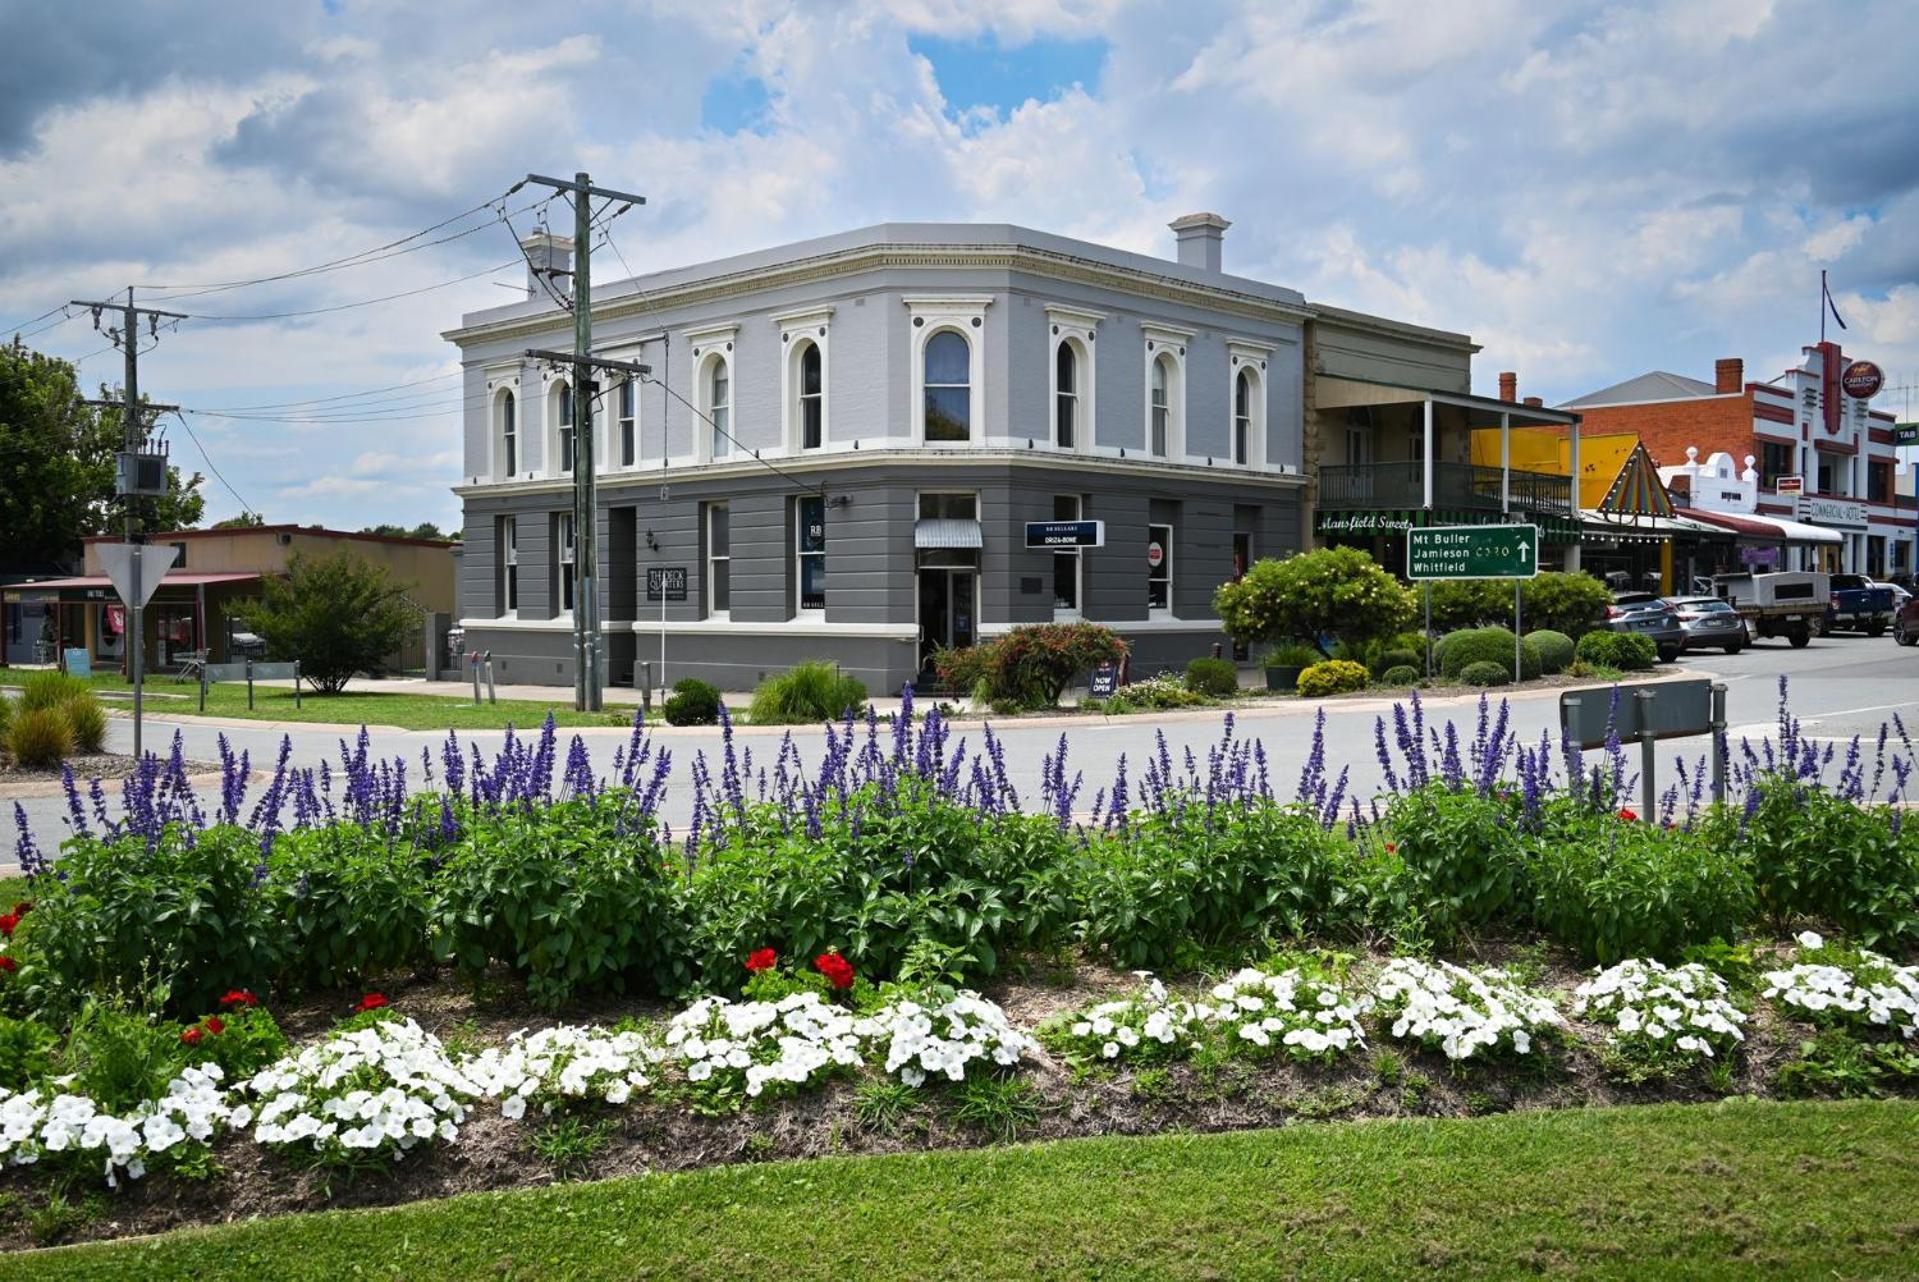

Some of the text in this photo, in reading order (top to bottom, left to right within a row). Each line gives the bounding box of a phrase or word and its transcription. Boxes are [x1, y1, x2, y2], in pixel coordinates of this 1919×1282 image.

[1899, 430, 1916, 439] TAB
[1318, 515, 1413, 531] Mansfield Sweets
[1413, 533, 1470, 545] Mt Buller
[1414, 548, 1470, 559] Jamieson
[1413, 561, 1466, 572] Whitfield
